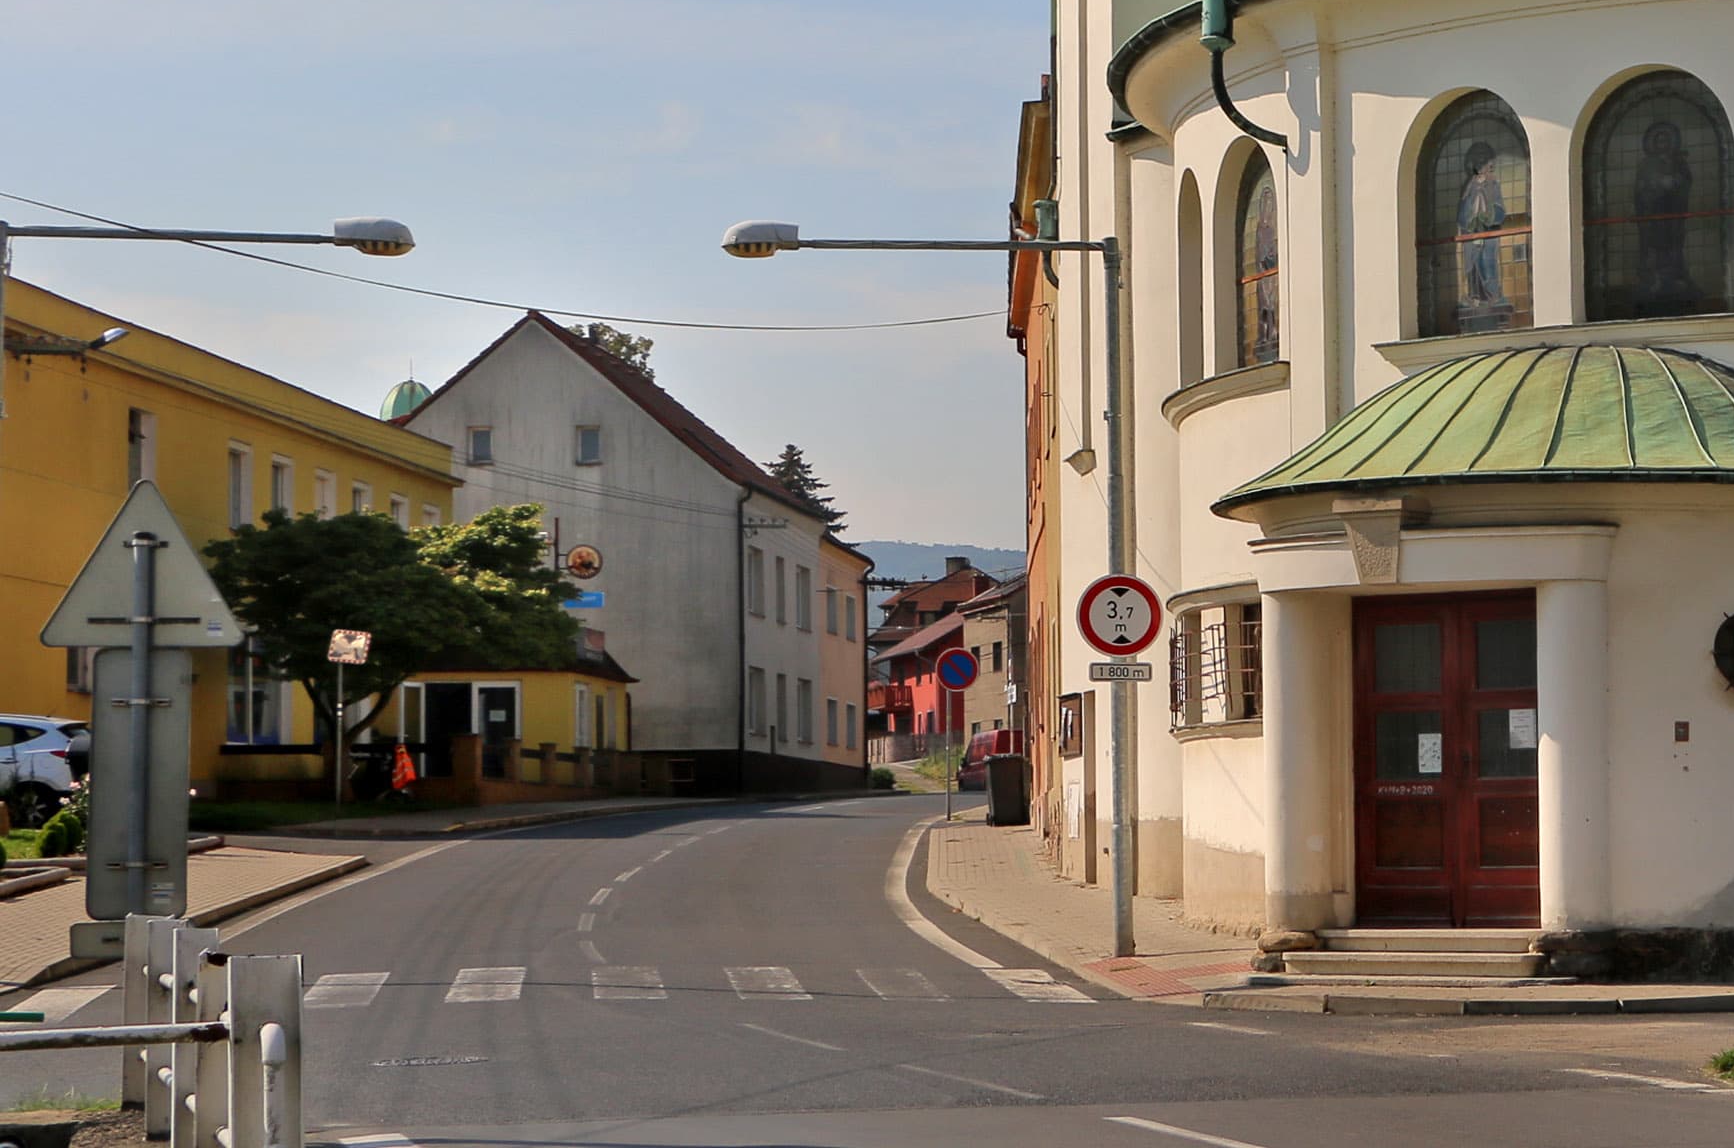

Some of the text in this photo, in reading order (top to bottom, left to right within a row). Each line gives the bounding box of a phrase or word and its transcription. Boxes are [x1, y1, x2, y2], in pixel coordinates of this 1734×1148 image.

[1115, 623, 1127, 632] m
[1108, 667, 1129, 677] 800
[1133, 669, 1144, 677] m
